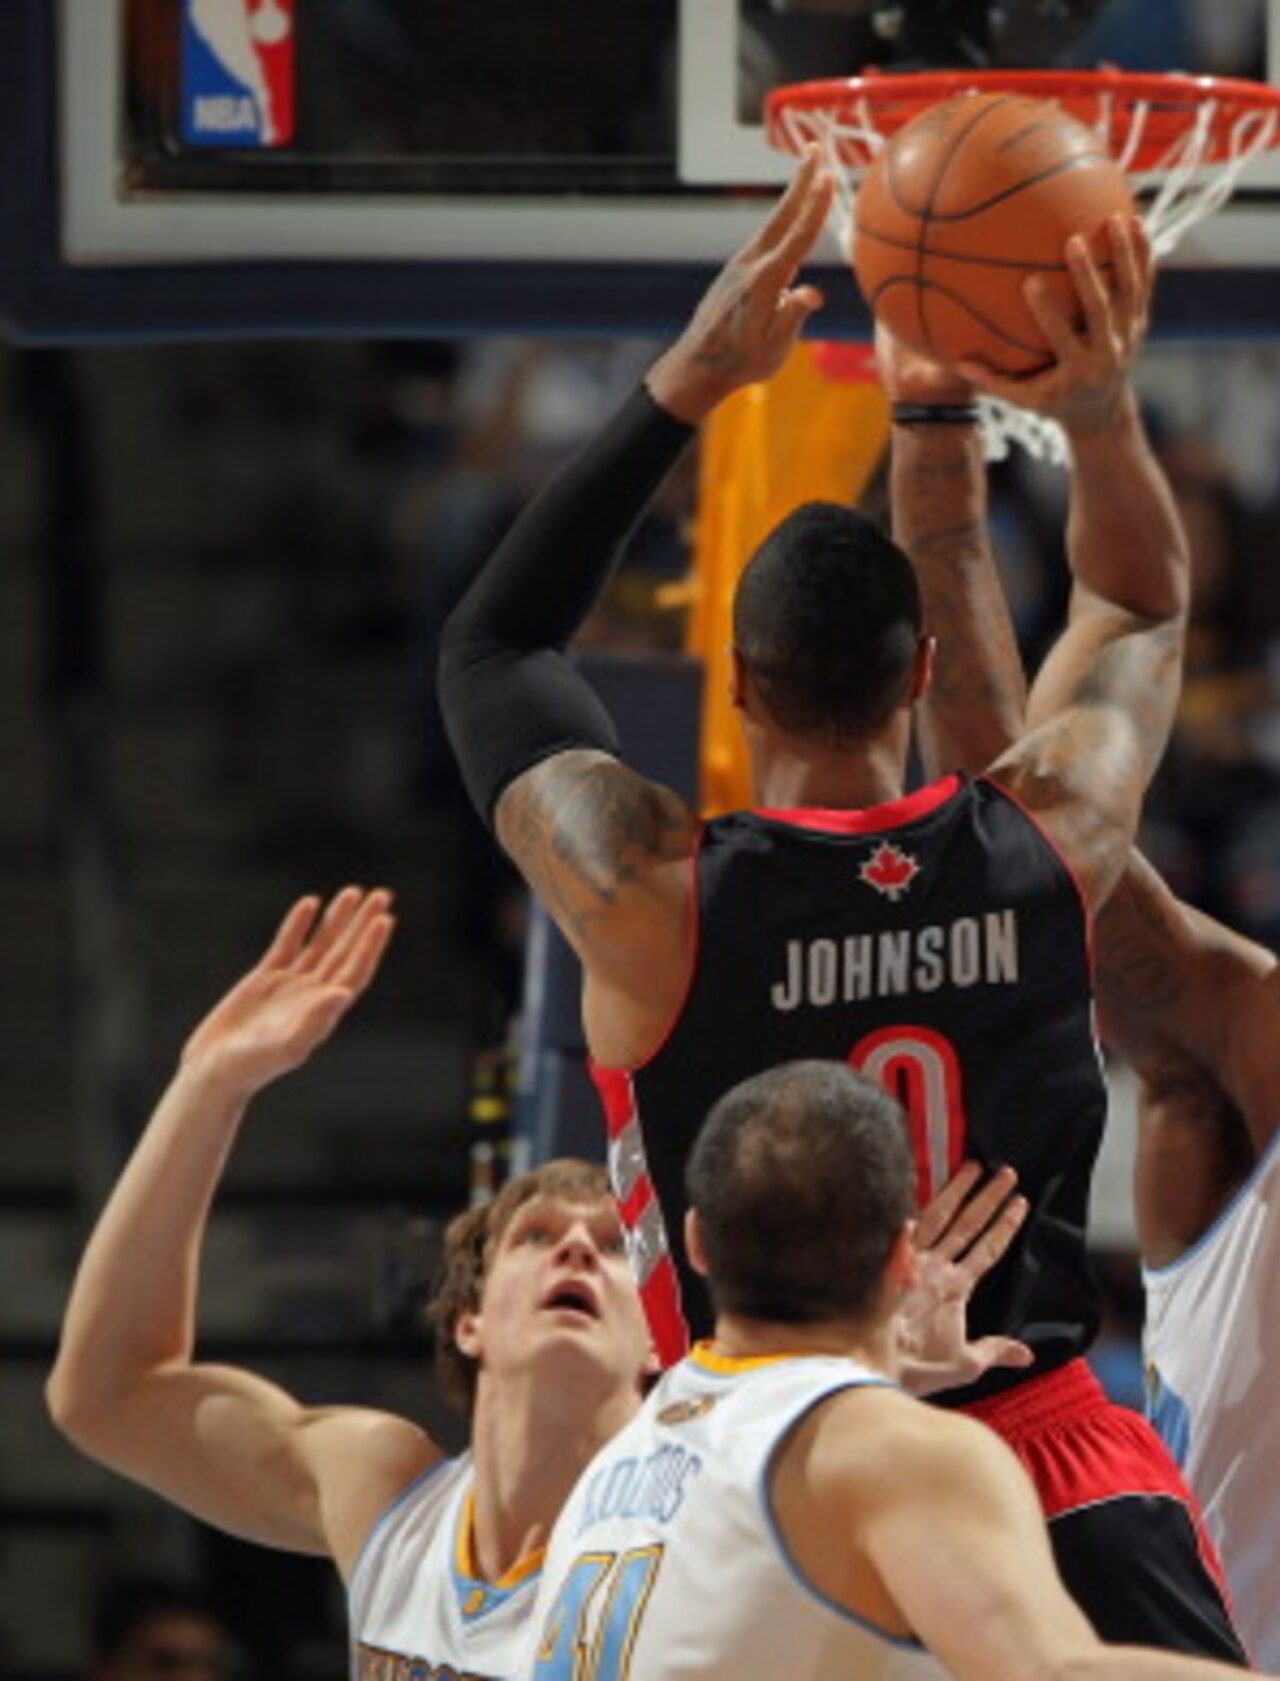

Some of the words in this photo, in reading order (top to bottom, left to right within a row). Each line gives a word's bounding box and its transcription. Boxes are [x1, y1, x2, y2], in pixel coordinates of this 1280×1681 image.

[193, 95, 256, 131] NBA
[770, 908, 1019, 1011] JOHNSON
[530, 1542, 665, 1681] 41
